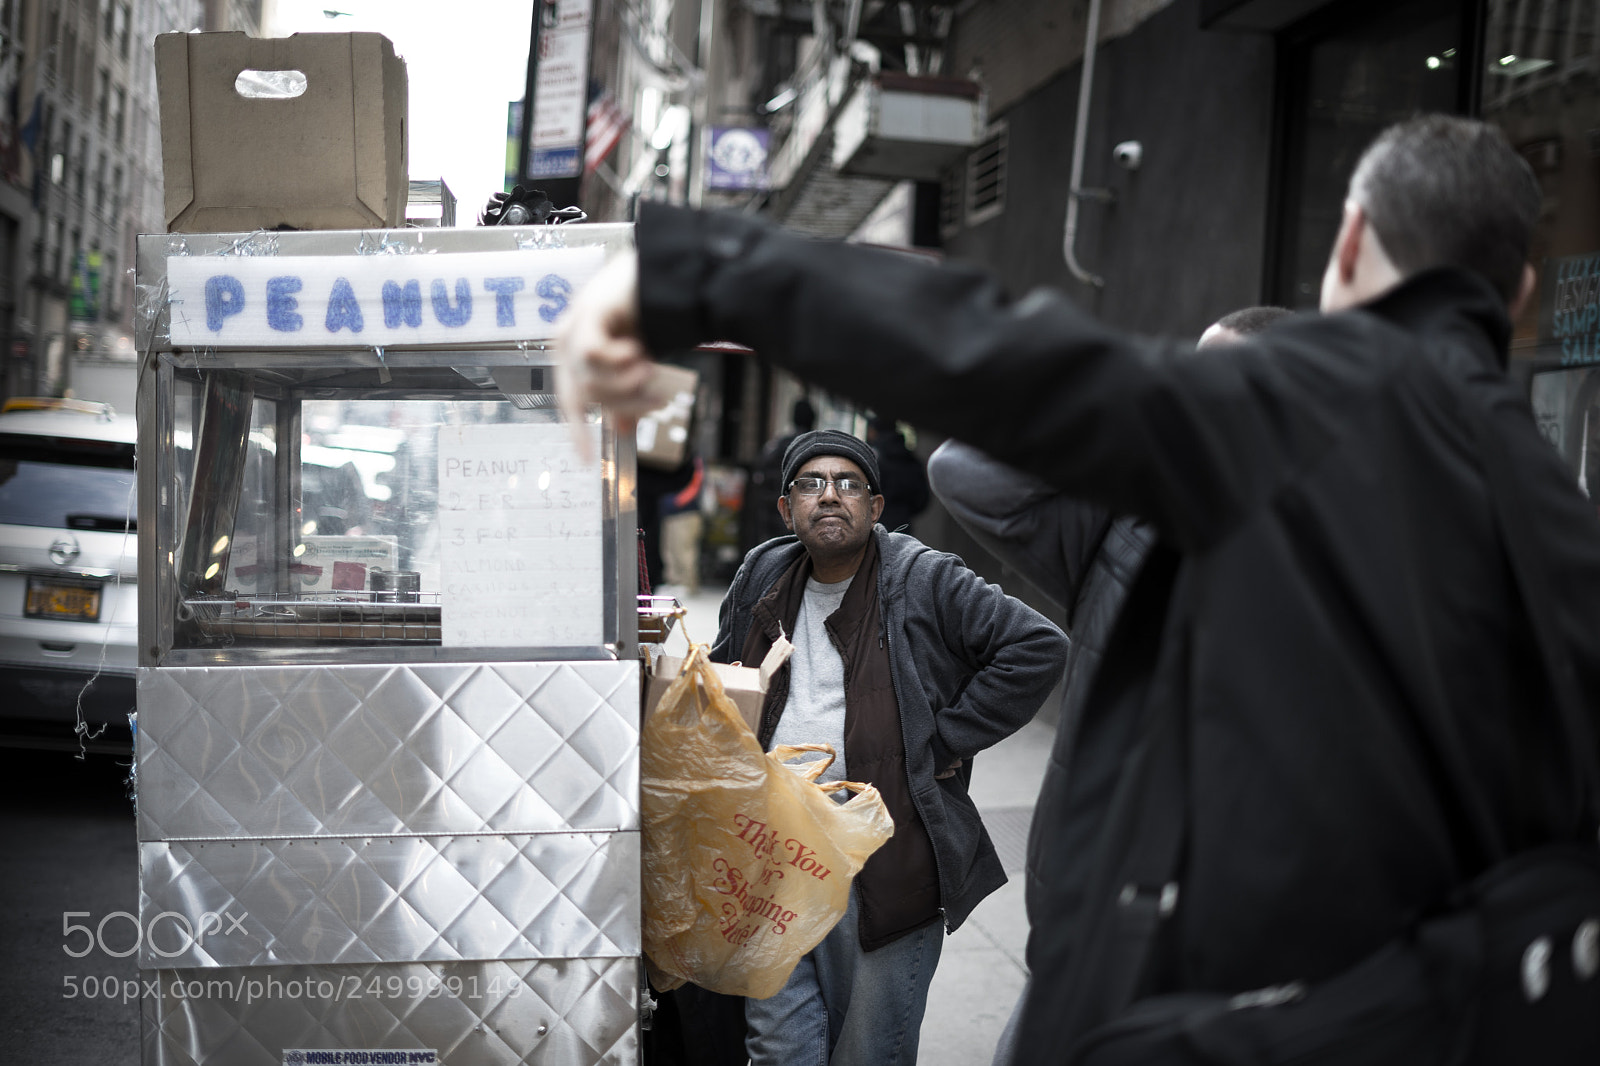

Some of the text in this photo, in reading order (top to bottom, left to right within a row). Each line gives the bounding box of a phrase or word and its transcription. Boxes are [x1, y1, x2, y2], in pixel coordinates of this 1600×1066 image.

[205, 273, 573, 334] PEANUTS
[1552, 302, 1600, 339] SAMP
[446, 457, 529, 478] PEANUT
[448, 491, 467, 512] 2
[451, 527, 466, 547] 3
[784, 838, 832, 881] You
[306, 1051, 435, 1065] MOBILE FOOD VENDOR NYC
